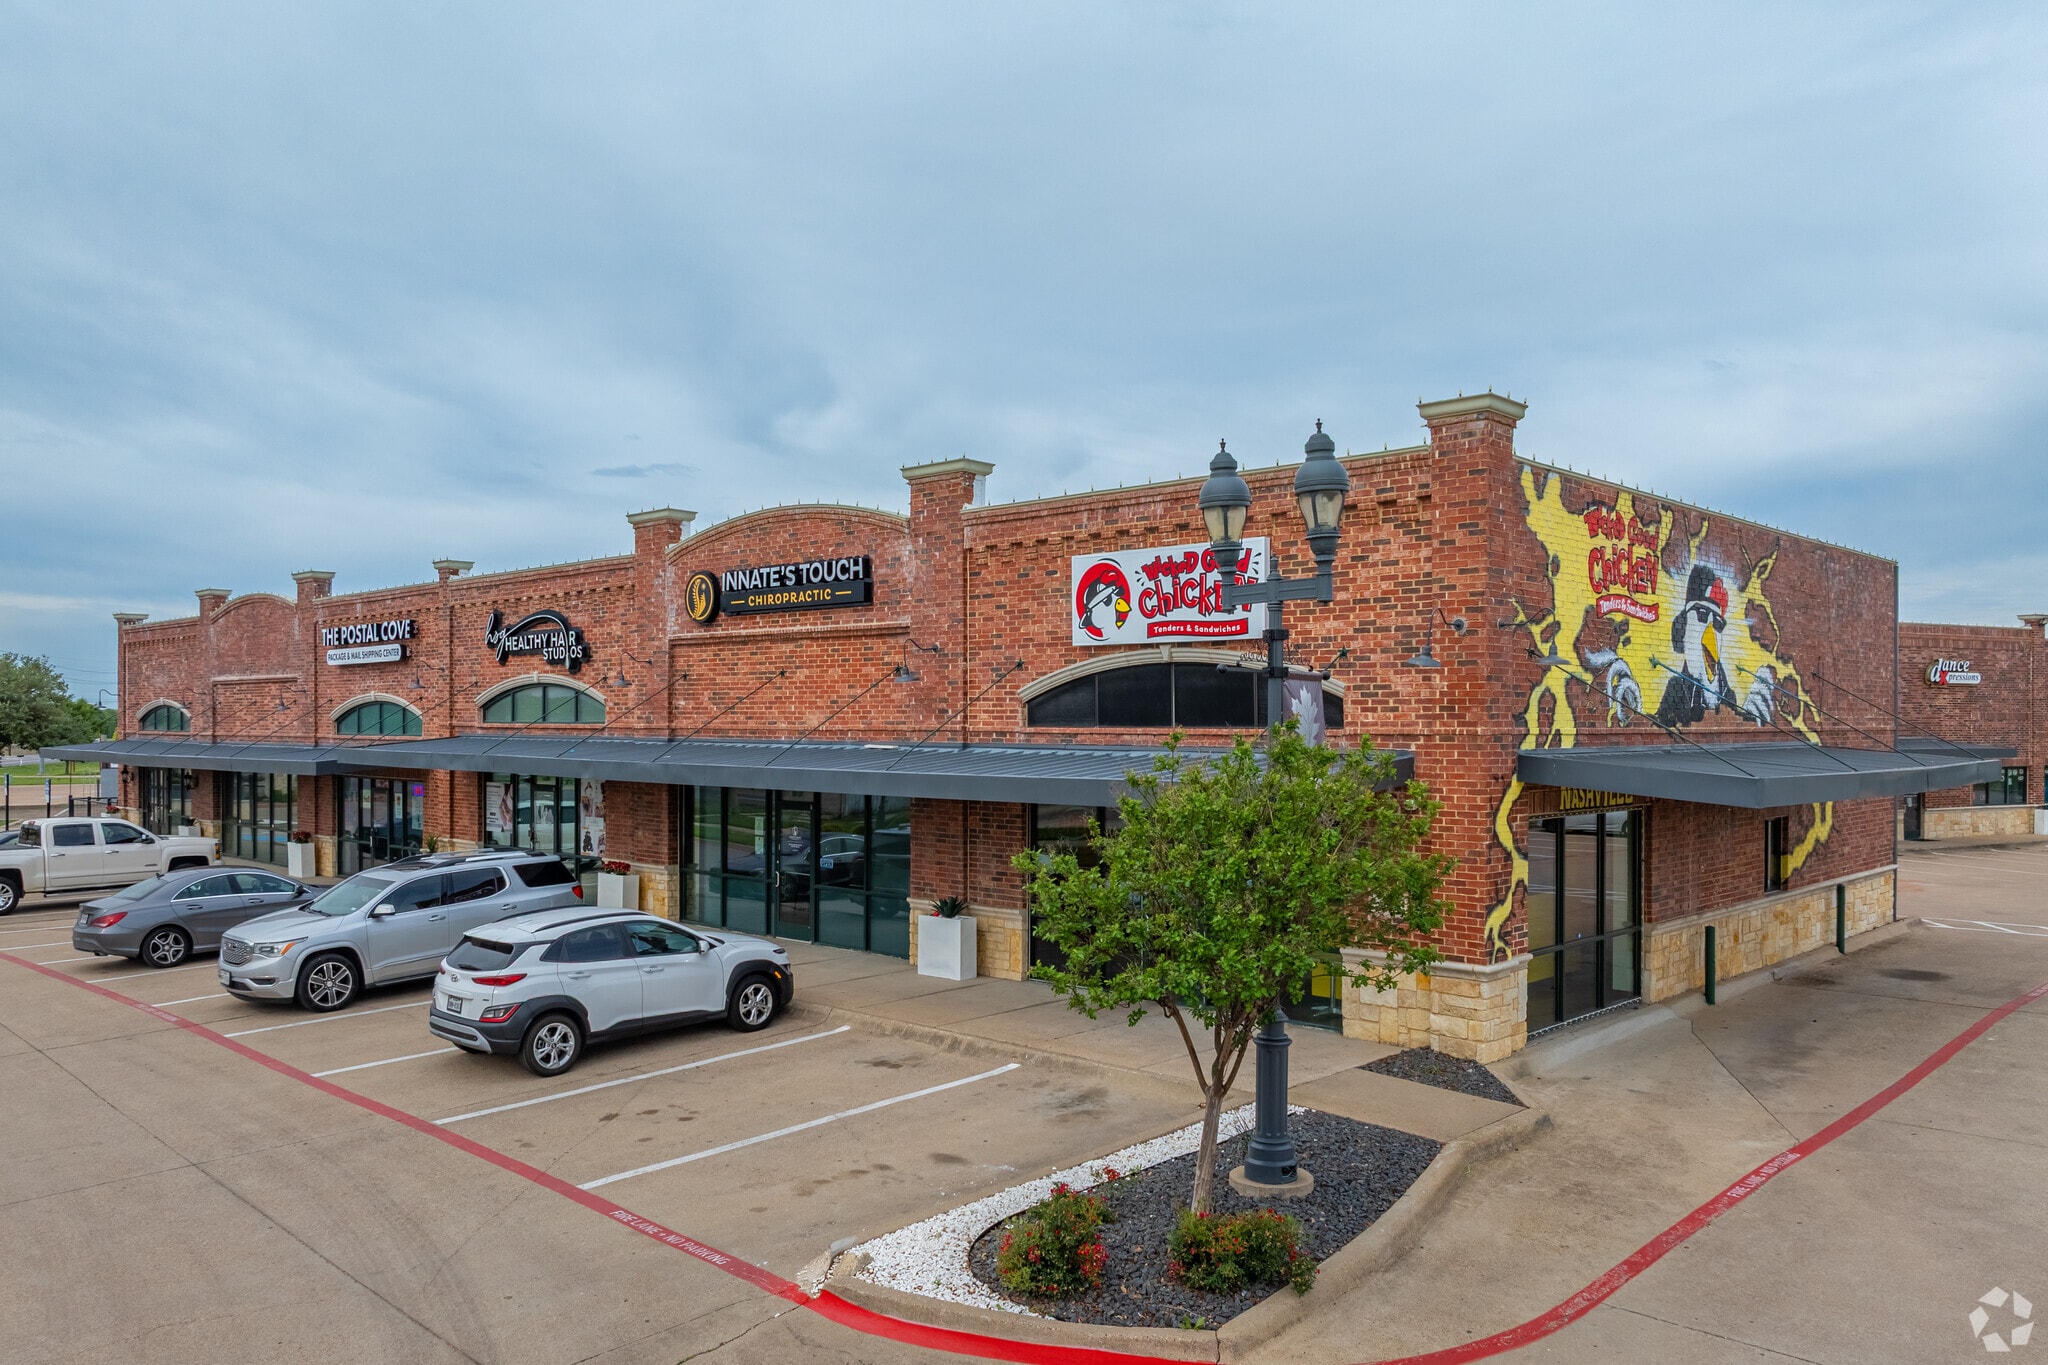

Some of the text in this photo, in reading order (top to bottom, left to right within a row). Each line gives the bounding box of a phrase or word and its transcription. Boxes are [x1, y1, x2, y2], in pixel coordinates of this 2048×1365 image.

[1201, 548, 1252, 573] Gd
[722, 557, 863, 592] INNATE'S TOUCH
[748, 588, 832, 607] CHIROPRACTIC
[1600, 596, 1621, 613] Tenders
[322, 619, 411, 646] THE POSTAL COVE
[1154, 624, 1241, 633] Tenders & Sandwiches
[505, 633, 548, 651] HEALTHY
[328, 653, 346, 661] PACKAGE
[351, 651, 361, 660] MAIL
[362, 649, 382, 659] SHIPPING
[383, 647, 399, 658] CENTER
[1930, 658, 1970, 682] dance
[609, 1210, 732, 1265] FIRE LANE NO PARKING
